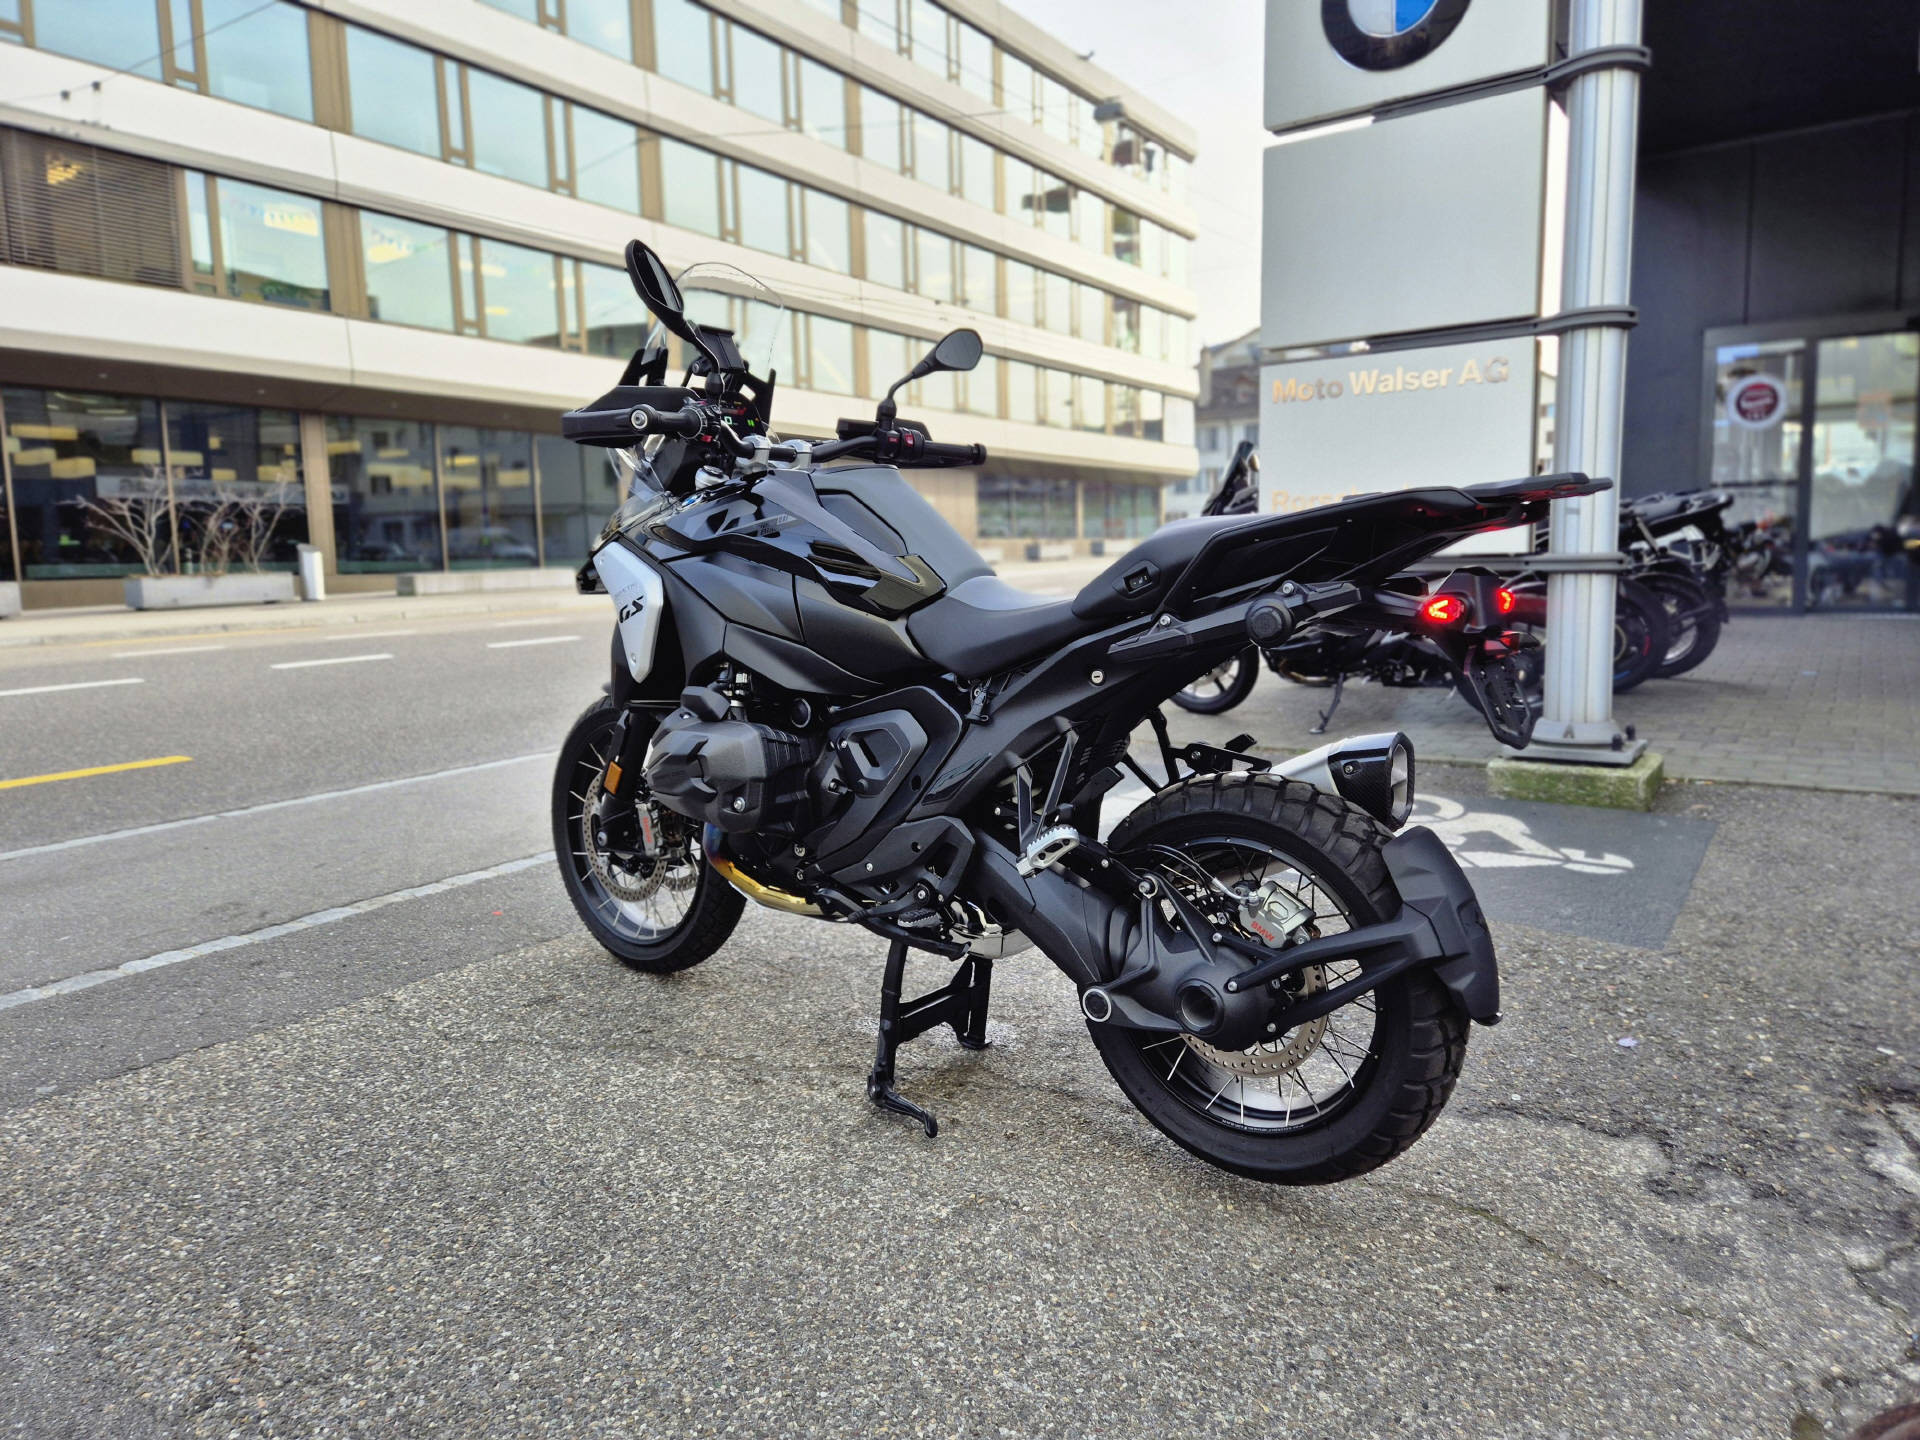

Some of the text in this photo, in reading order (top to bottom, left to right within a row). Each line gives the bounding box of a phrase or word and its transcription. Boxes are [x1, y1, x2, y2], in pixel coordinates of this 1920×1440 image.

[1272, 357, 1509, 404] Moto Walser AG
[619, 595, 644, 623] GS
[1251, 921, 1275, 941] BMW
